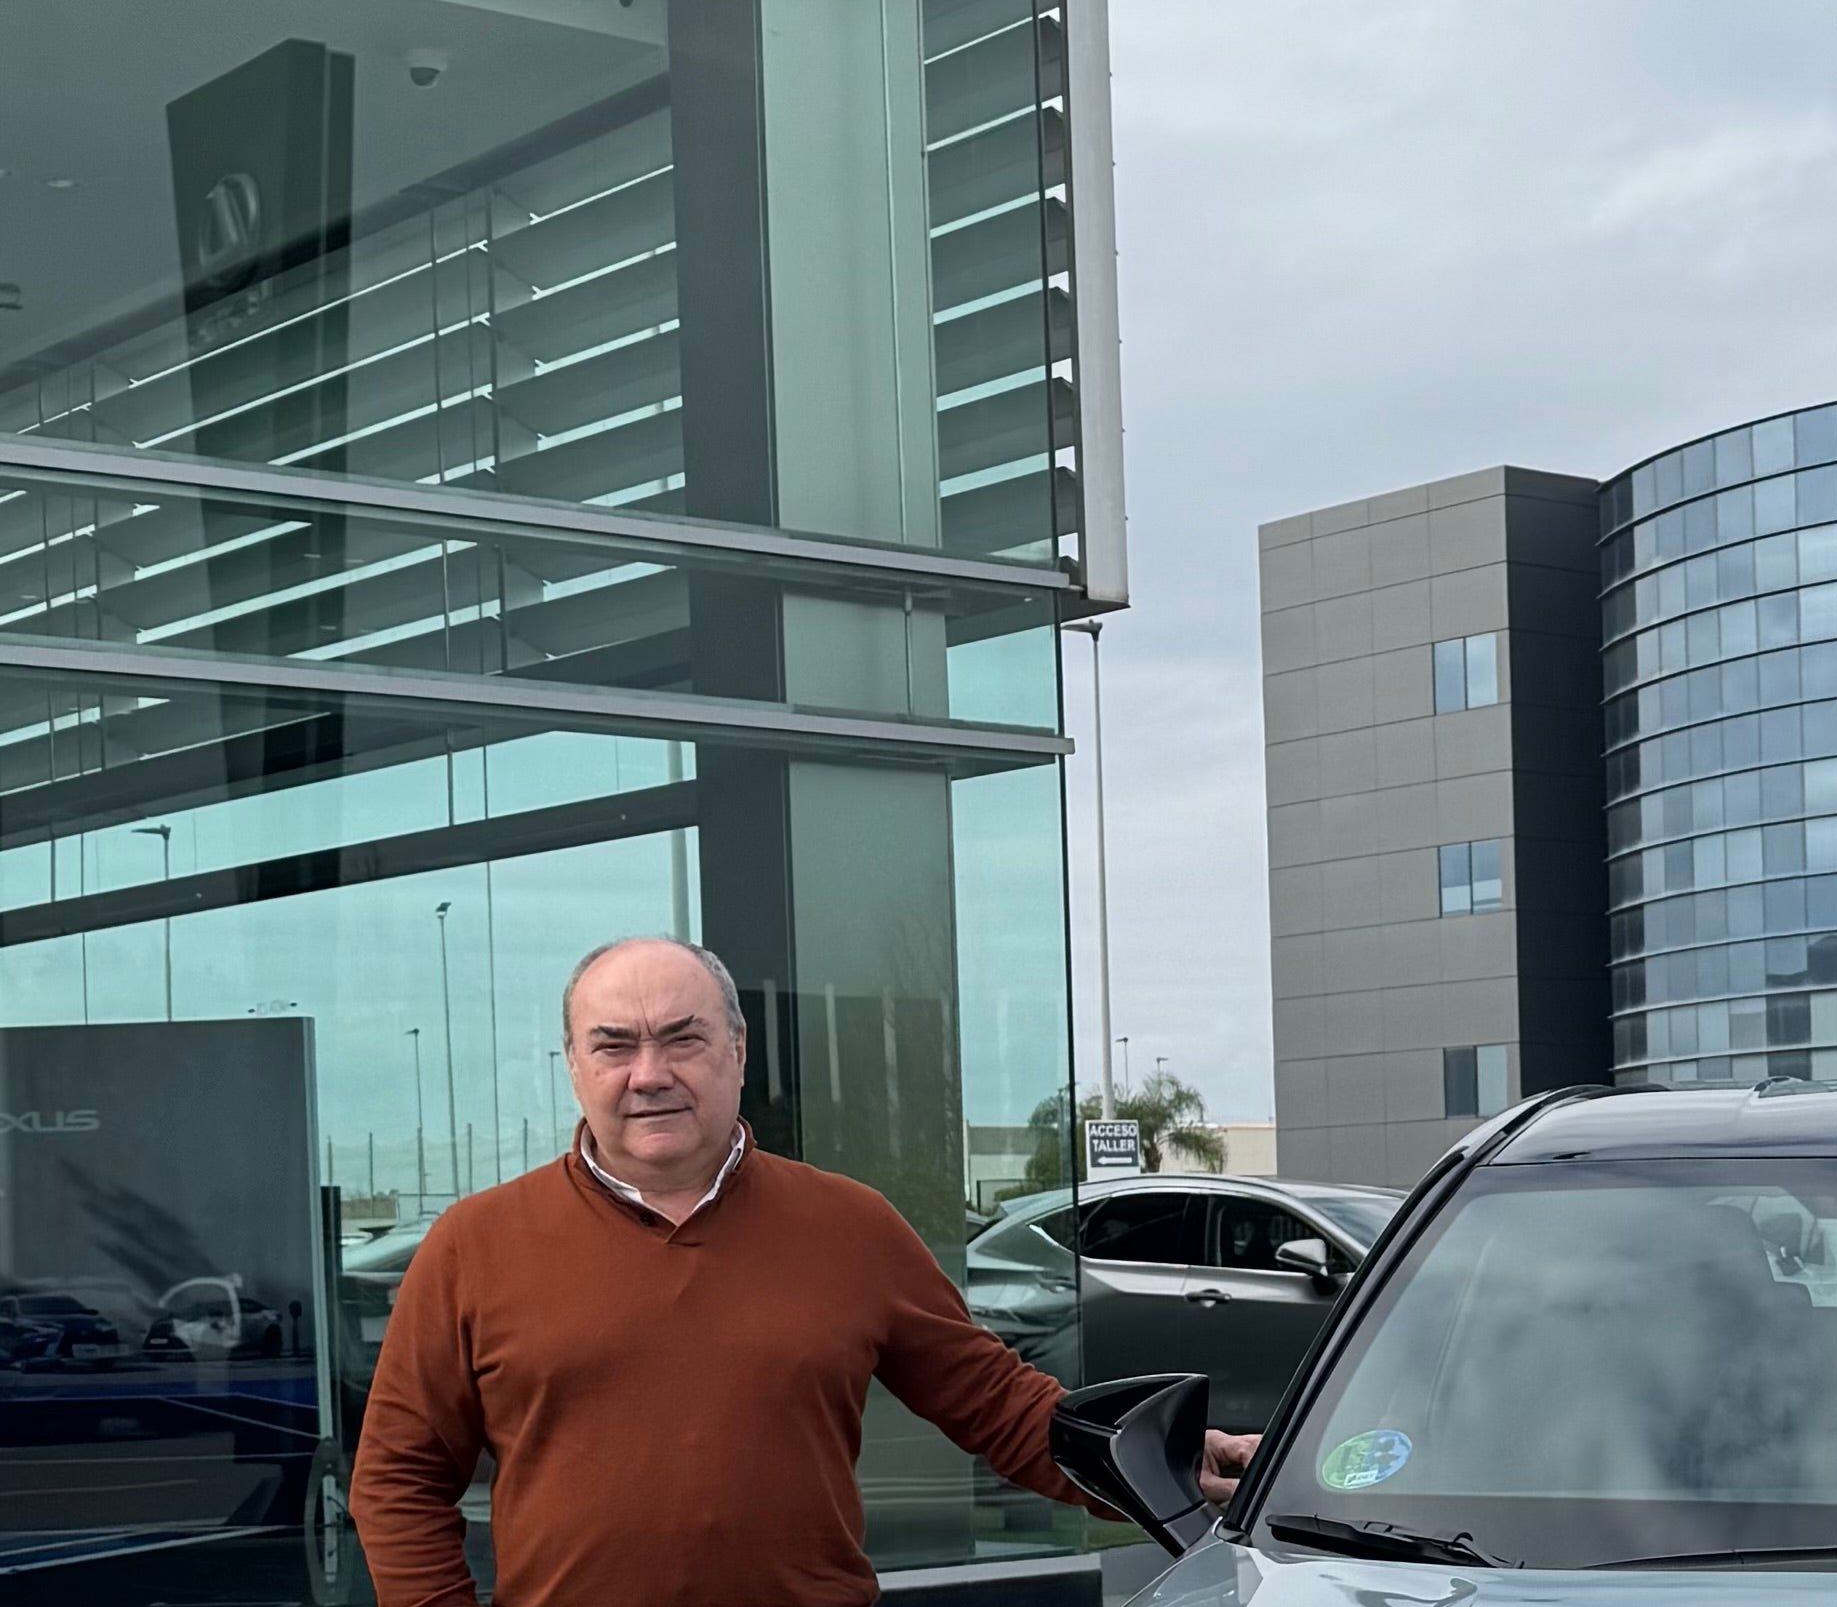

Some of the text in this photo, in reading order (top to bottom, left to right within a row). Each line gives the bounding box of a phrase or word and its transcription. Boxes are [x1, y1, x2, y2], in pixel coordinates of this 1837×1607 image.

[0, 1109, 100, 1133] XUS
[1090, 1124, 1137, 1137] ACCESO
[1092, 1139, 1136, 1152] TALLER
